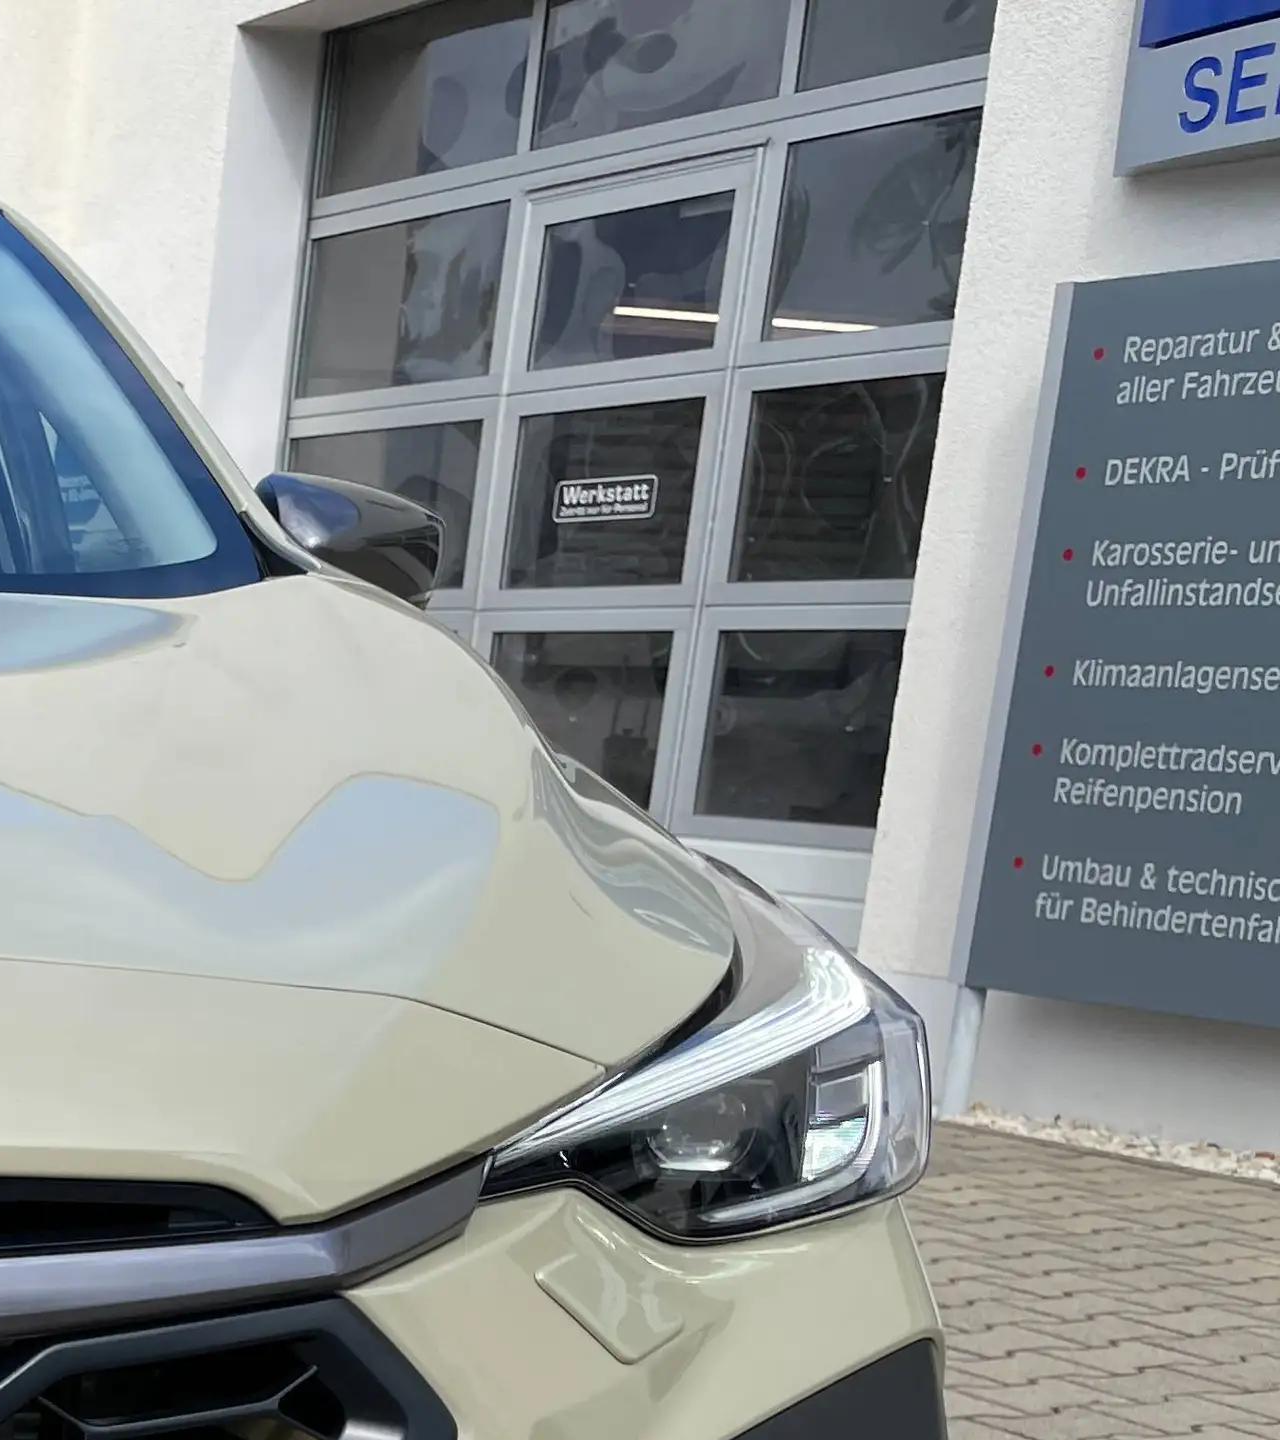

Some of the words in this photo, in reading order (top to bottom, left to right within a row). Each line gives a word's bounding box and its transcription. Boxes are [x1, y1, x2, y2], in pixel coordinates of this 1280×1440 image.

[1179, 42, 1280, 133] SE
[1123, 328, 1260, 366] Reparatur
[1116, 375, 1175, 405] aller
[1181, 369, 1280, 400] Fahrze
[1104, 455, 1190, 486] DEKRA
[1219, 449, 1280, 481] Prüf
[562, 483, 650, 505] Werkstatt
[1092, 536, 1238, 567] Karosserie-
[1248, 540, 1280, 564] un
[1086, 577, 1280, 607] Unfallinstands
[1072, 659, 1280, 694] Klimaanlagense
[1053, 777, 1242, 815] Reifenpension
[1041, 854, 1132, 888] Umbau
[1140, 862, 1157, 891] &
[1166, 865, 1280, 902] technisc
[1035, 892, 1074, 922] für
